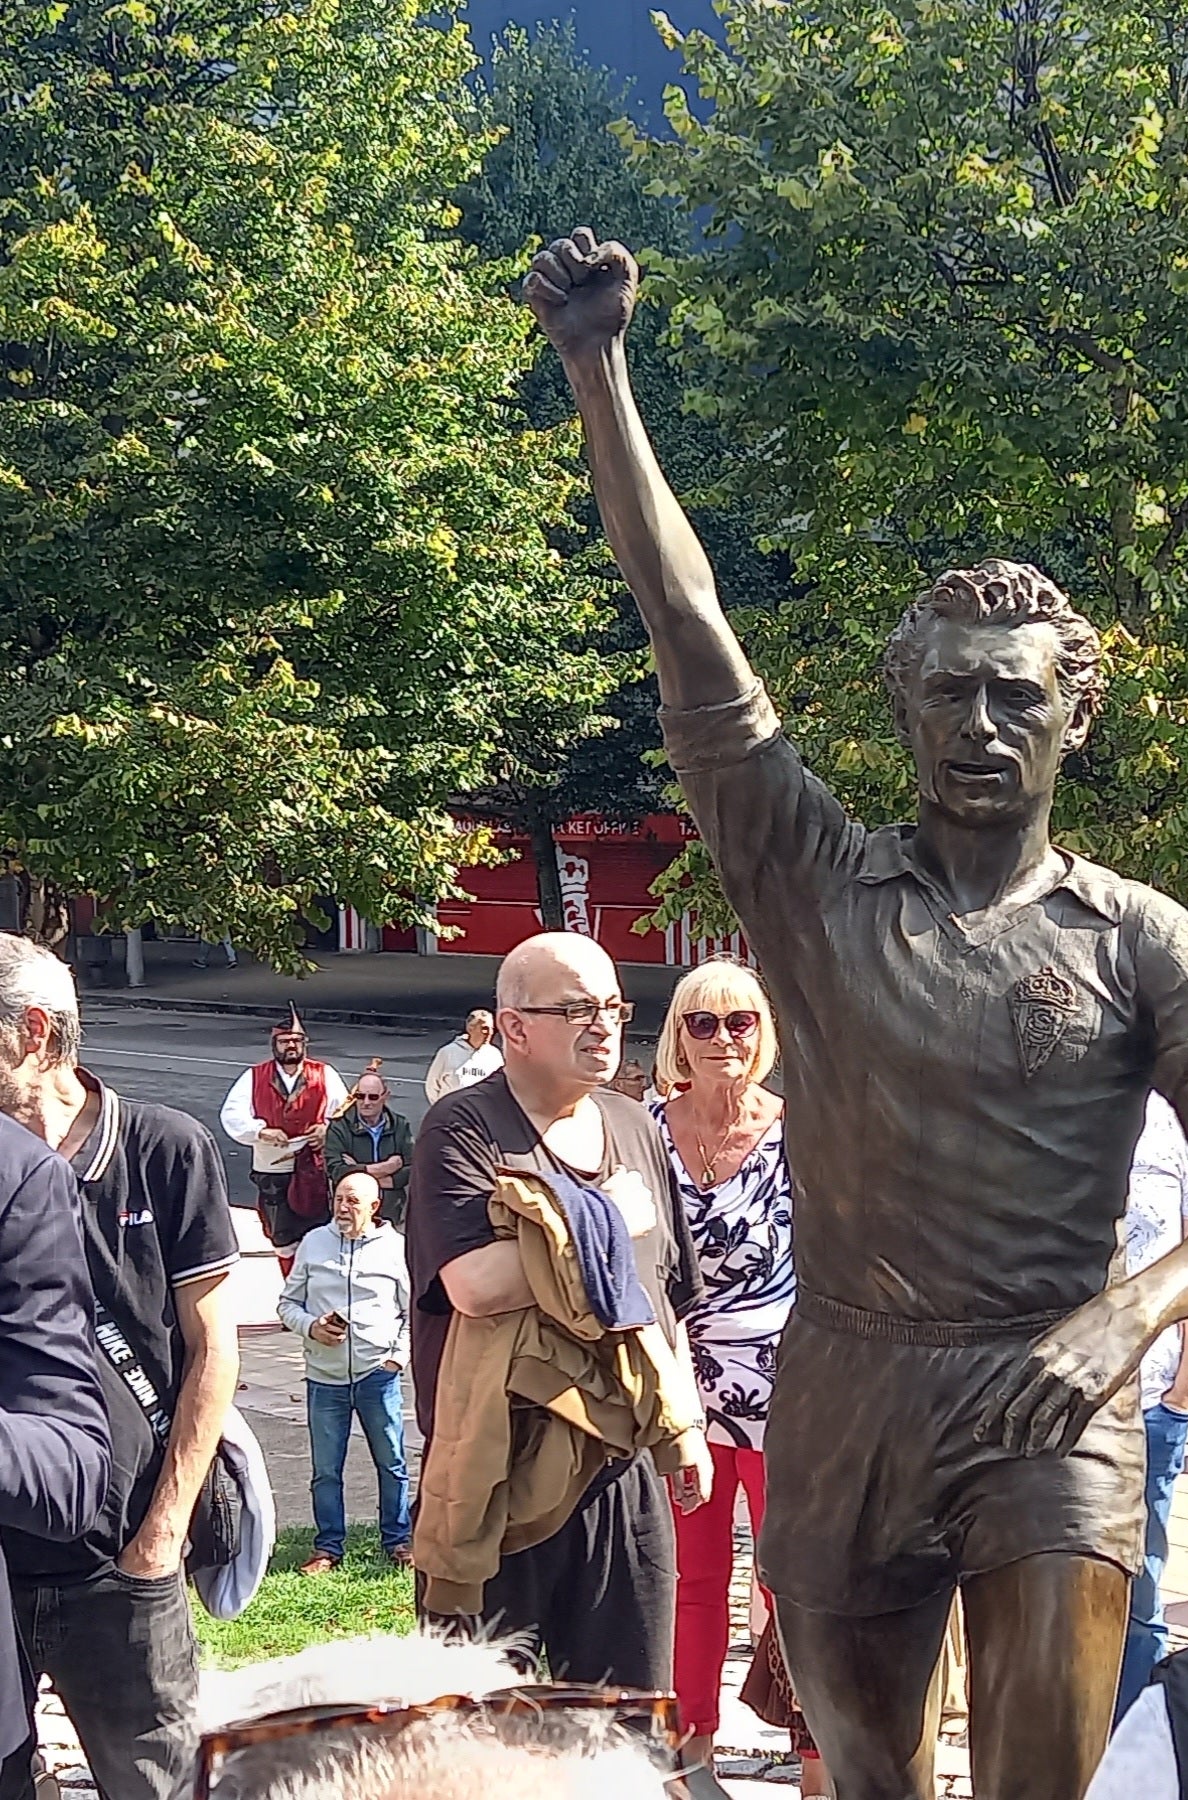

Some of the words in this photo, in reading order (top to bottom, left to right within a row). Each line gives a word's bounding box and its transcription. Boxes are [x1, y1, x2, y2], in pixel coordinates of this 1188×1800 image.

[119, 1210, 153, 1226] FILA
[95, 1321, 134, 1365] NIKE
[123, 1365, 158, 1407] NIKE
